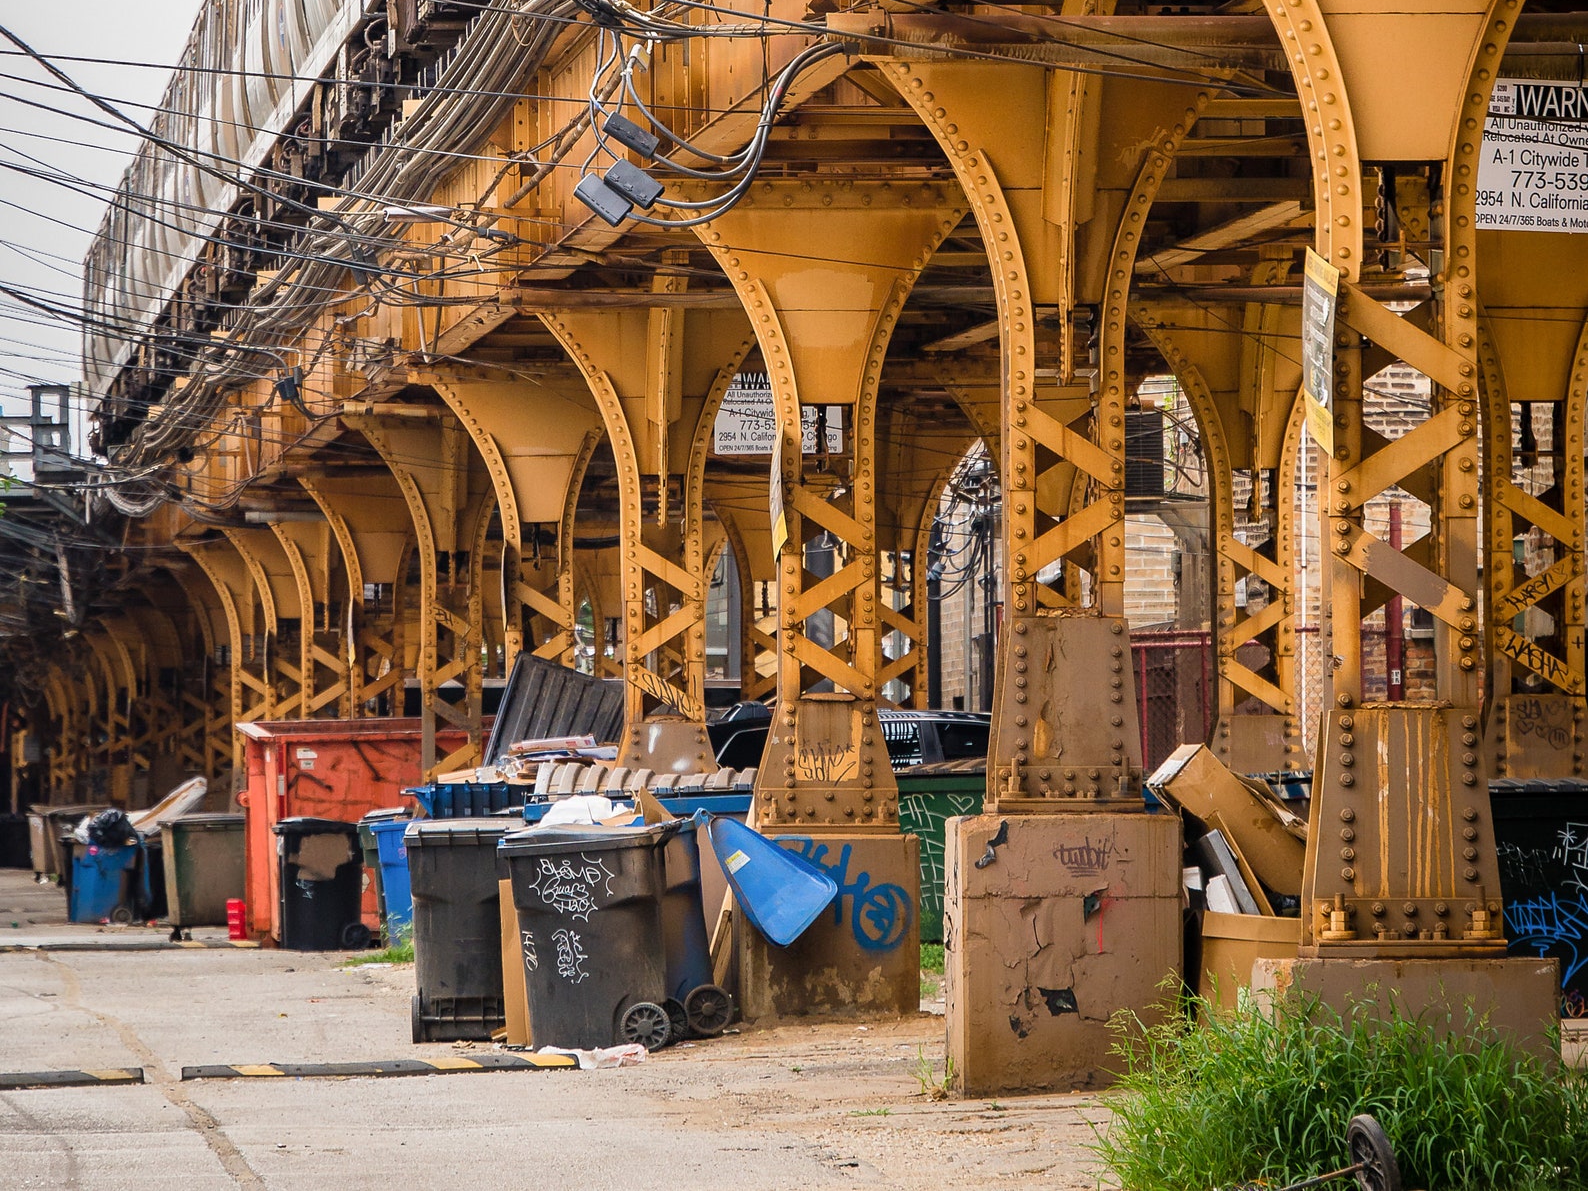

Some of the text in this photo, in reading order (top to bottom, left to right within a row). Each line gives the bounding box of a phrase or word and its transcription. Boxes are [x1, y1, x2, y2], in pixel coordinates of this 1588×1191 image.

[1491, 117, 1504, 129] All
[1508, 117, 1581, 133] Unauthorized
[1483, 129, 1539, 143] Relocated
[1543, 132, 1555, 144] At
[1492, 148, 1514, 164] A-1
[1520, 149, 1580, 170] Citywide
[1511, 170, 1588, 191] 773-539
[1475, 190, 1503, 206] 2954
[1511, 192, 1525, 208] N.
[1499, 214, 1535, 226] 24/7/365
[1536, 216, 1559, 227] Boats
[1561, 217, 1568, 227] &
[745, 408, 775, 419] Citywid
[719, 432, 736, 441] 2954
